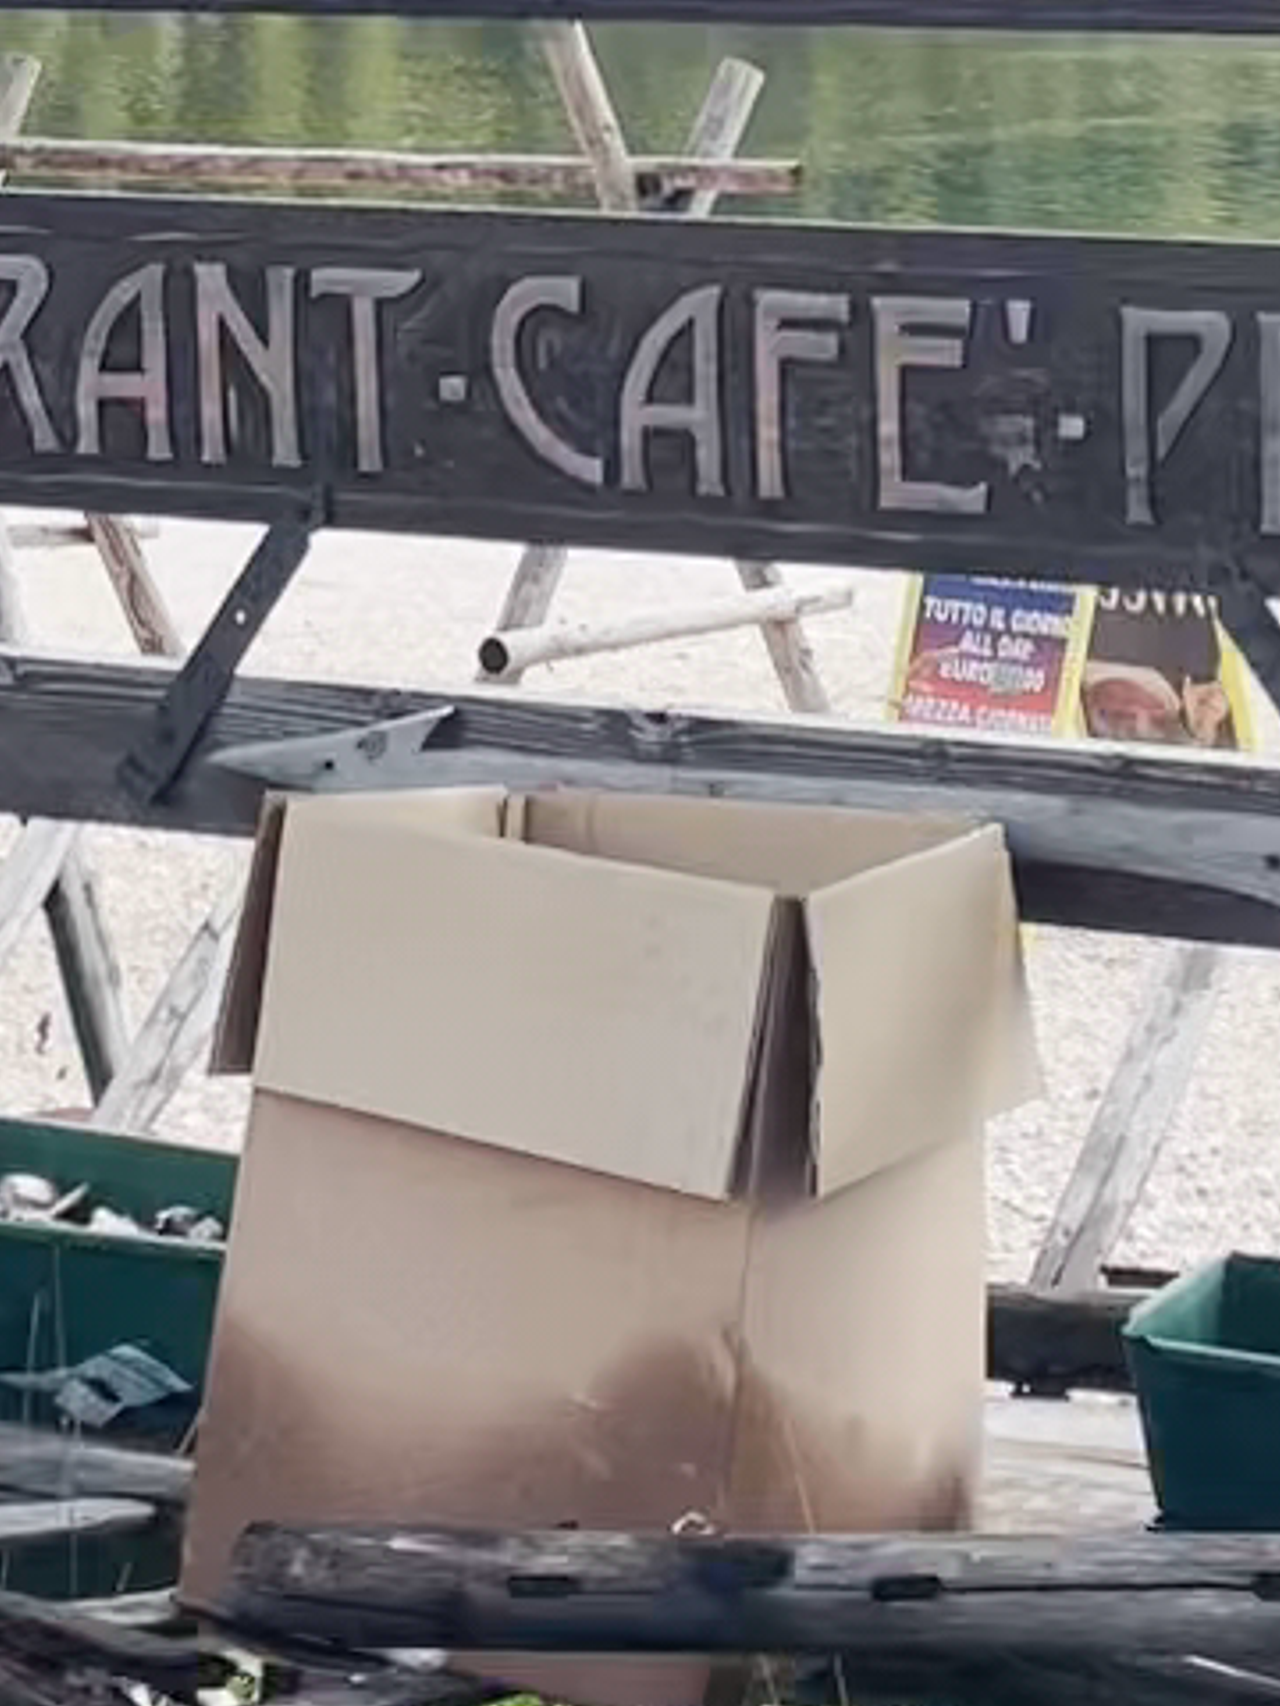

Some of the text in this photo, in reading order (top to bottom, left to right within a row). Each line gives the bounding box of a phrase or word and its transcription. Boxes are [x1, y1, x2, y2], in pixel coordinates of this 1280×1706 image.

[490, 273, 1034, 514] CAFE'
[923, 595, 987, 629] TUTTO
[990, 606, 1006, 630] IL
[958, 629, 994, 658] ALL
